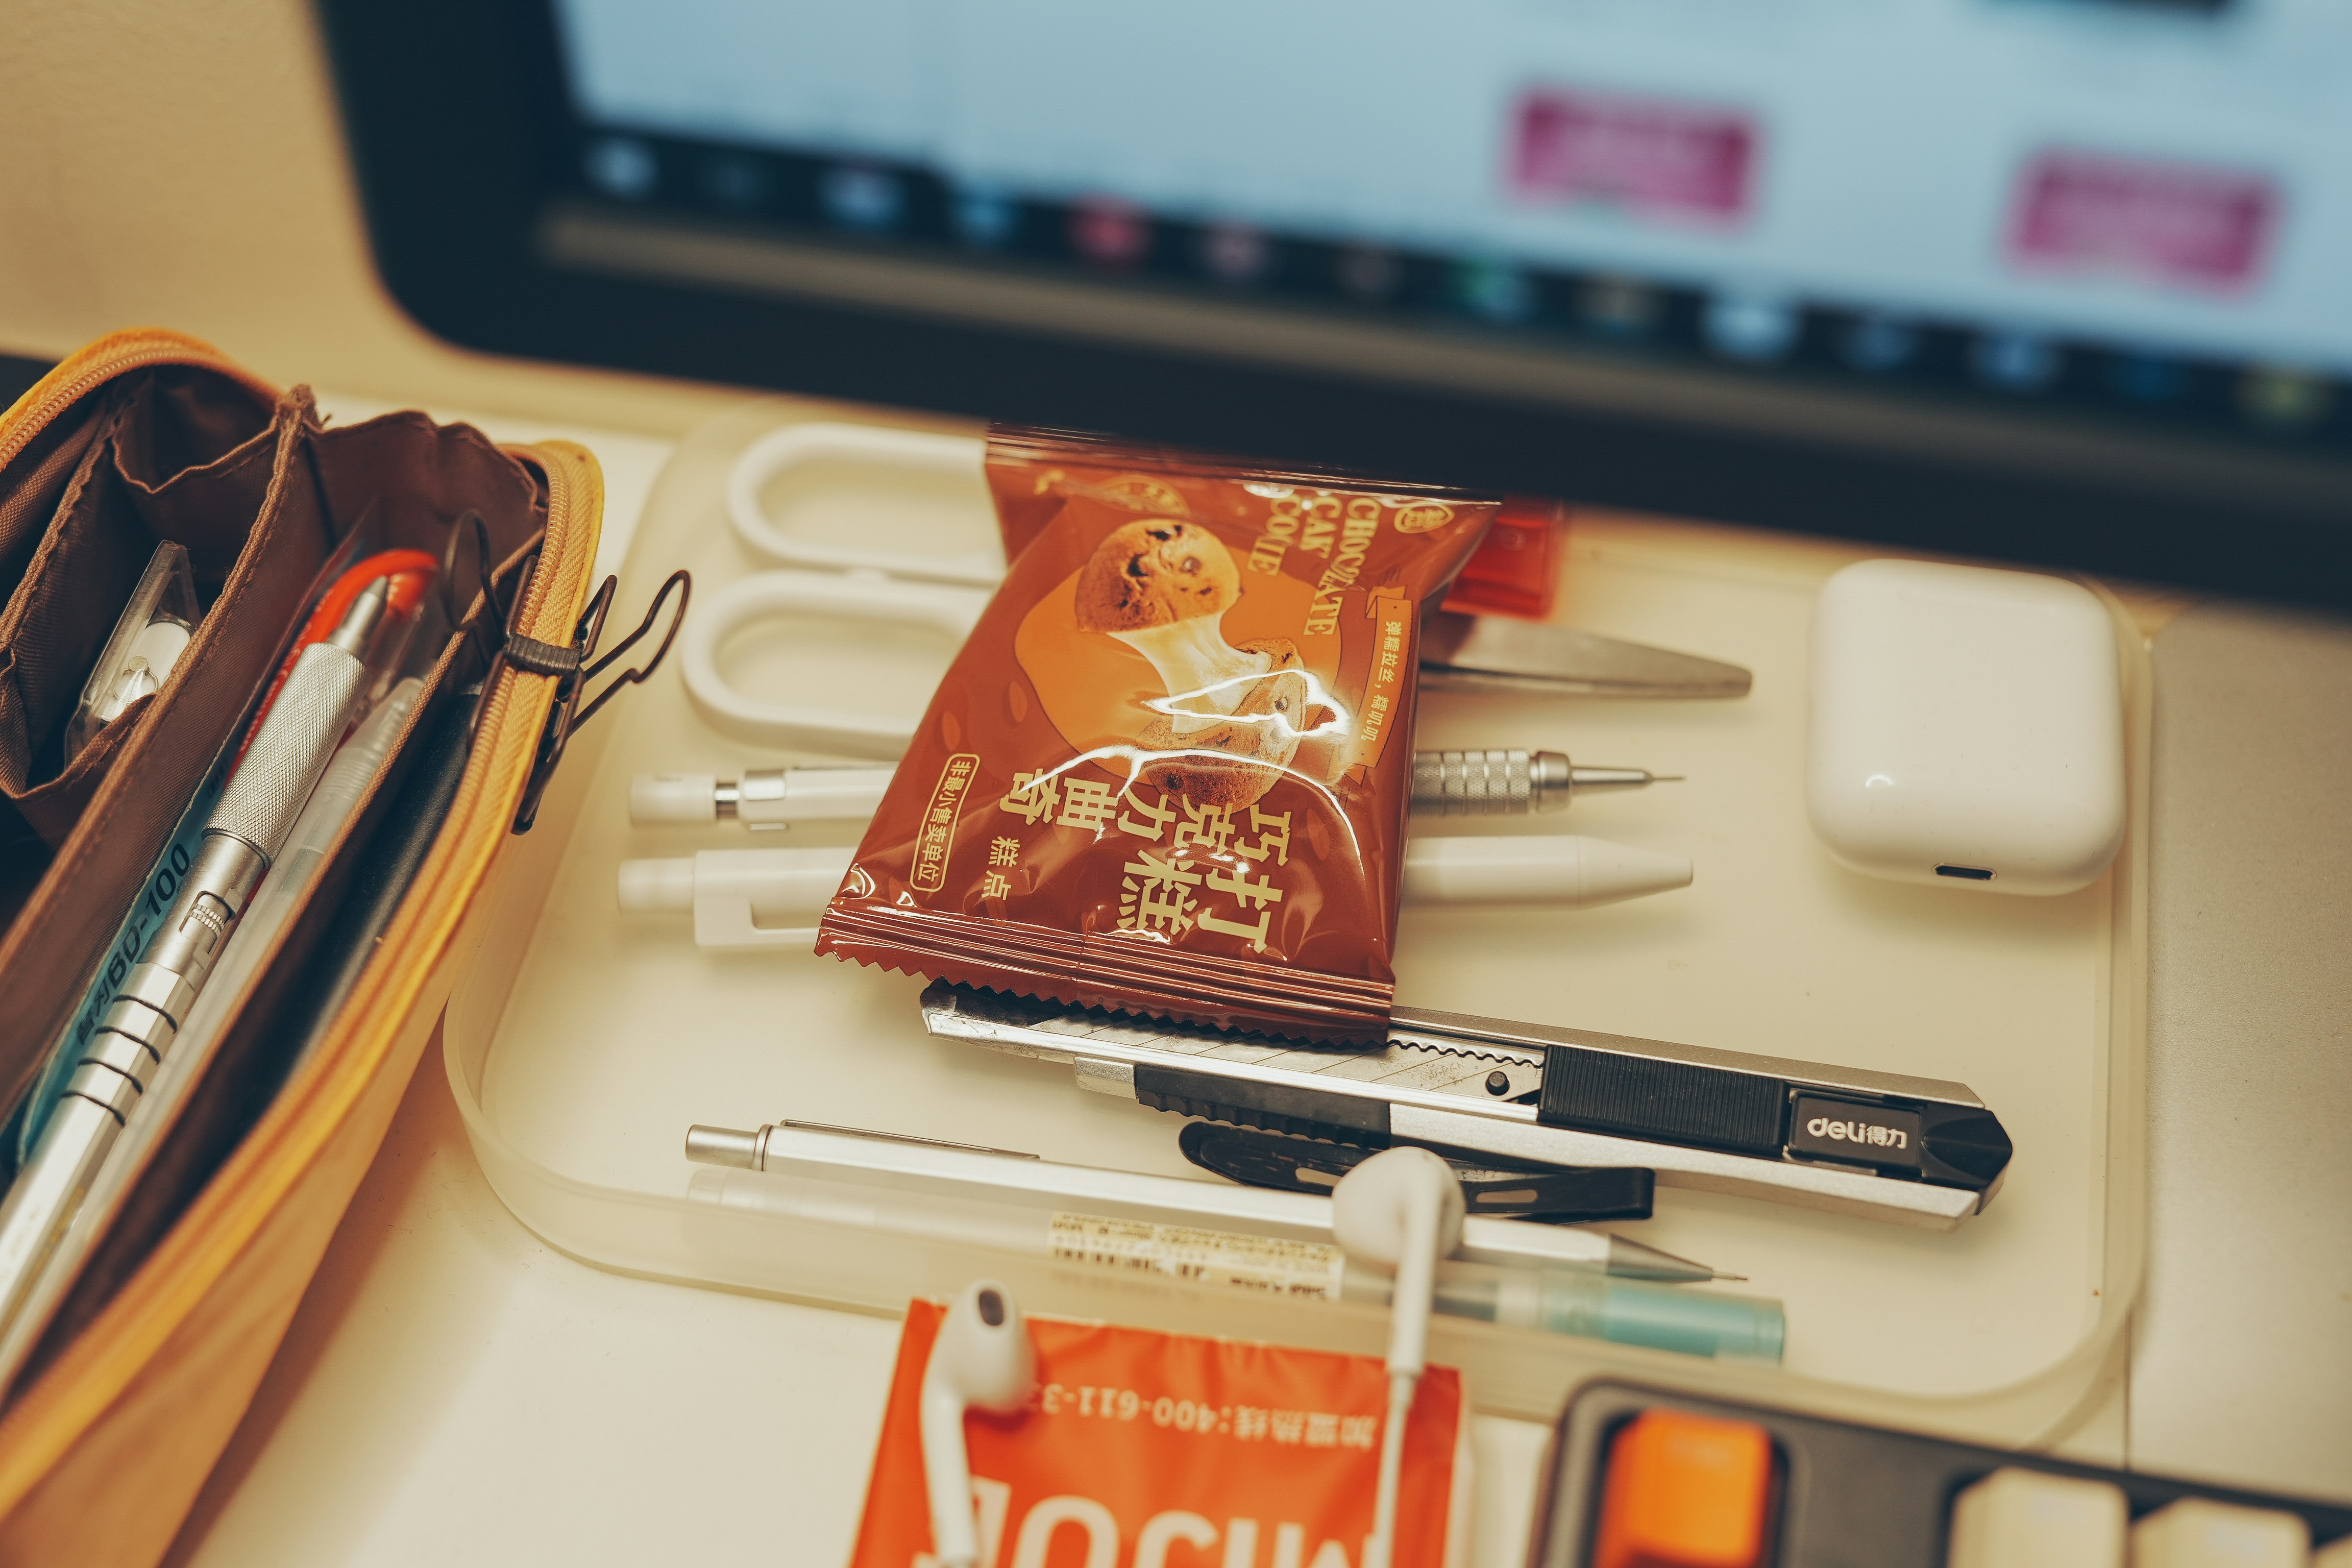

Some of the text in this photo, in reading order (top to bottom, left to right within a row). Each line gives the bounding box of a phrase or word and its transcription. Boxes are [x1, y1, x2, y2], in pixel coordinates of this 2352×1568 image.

[918, 760, 971, 882] 非最小售卖单位
[999, 768, 1292, 866] 巧克力曲奇
[981, 836, 1020, 900] 糕点
[1116, 849, 1283, 953] 打糕
